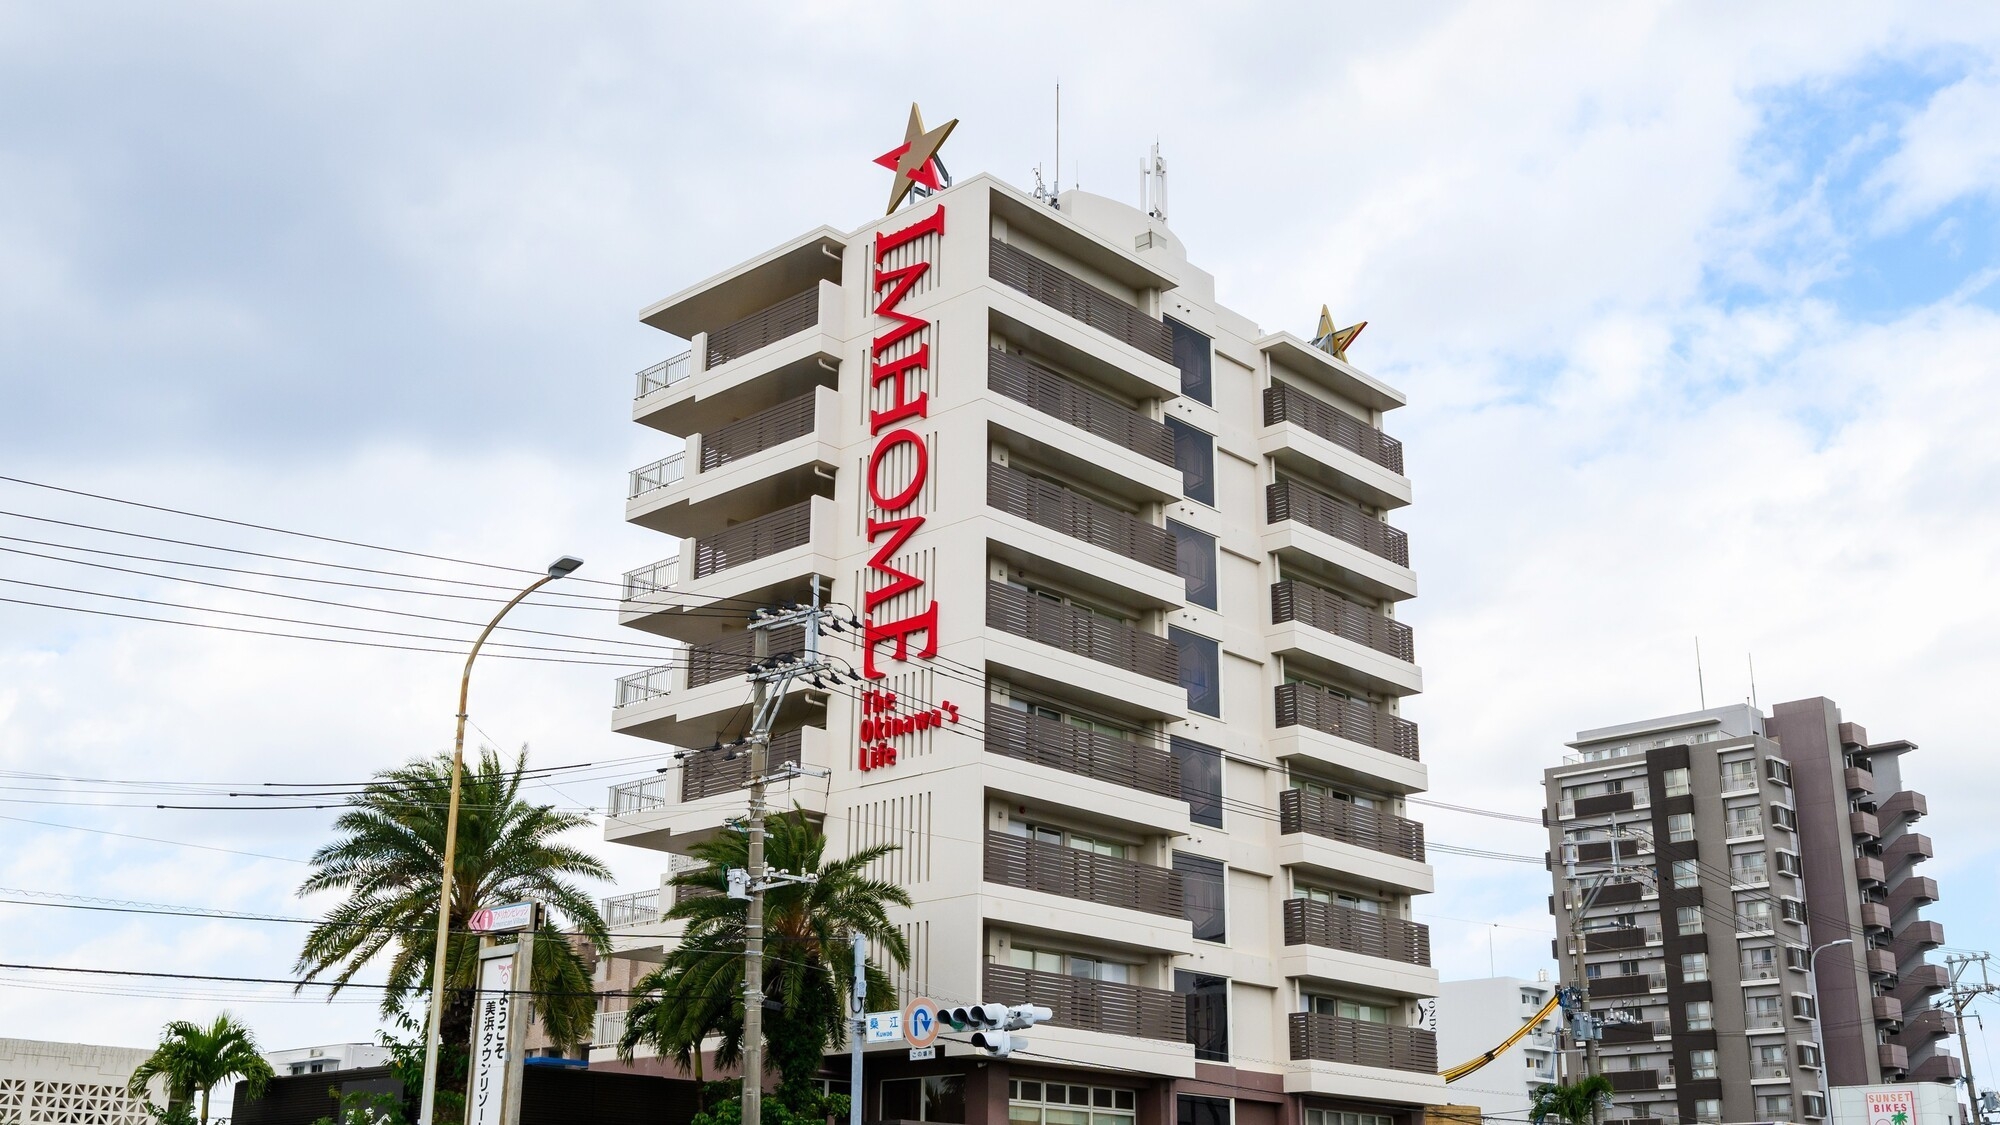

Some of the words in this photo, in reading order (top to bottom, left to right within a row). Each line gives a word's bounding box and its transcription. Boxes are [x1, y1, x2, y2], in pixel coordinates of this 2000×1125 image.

[864, 203, 945, 679] IMHOME
[862, 689, 897, 716] The
[860, 700, 959, 744] Okinawa's
[858, 742, 897, 771] Life
[494, 989, 508, 1060] ようこそ
[870, 1016, 898, 1029] 桑江
[478, 1000, 496, 1125] 美浜タウンリゾー
[1868, 1093, 1910, 1103] SUNSET
[1873, 1103, 1907, 1113] BIKES
